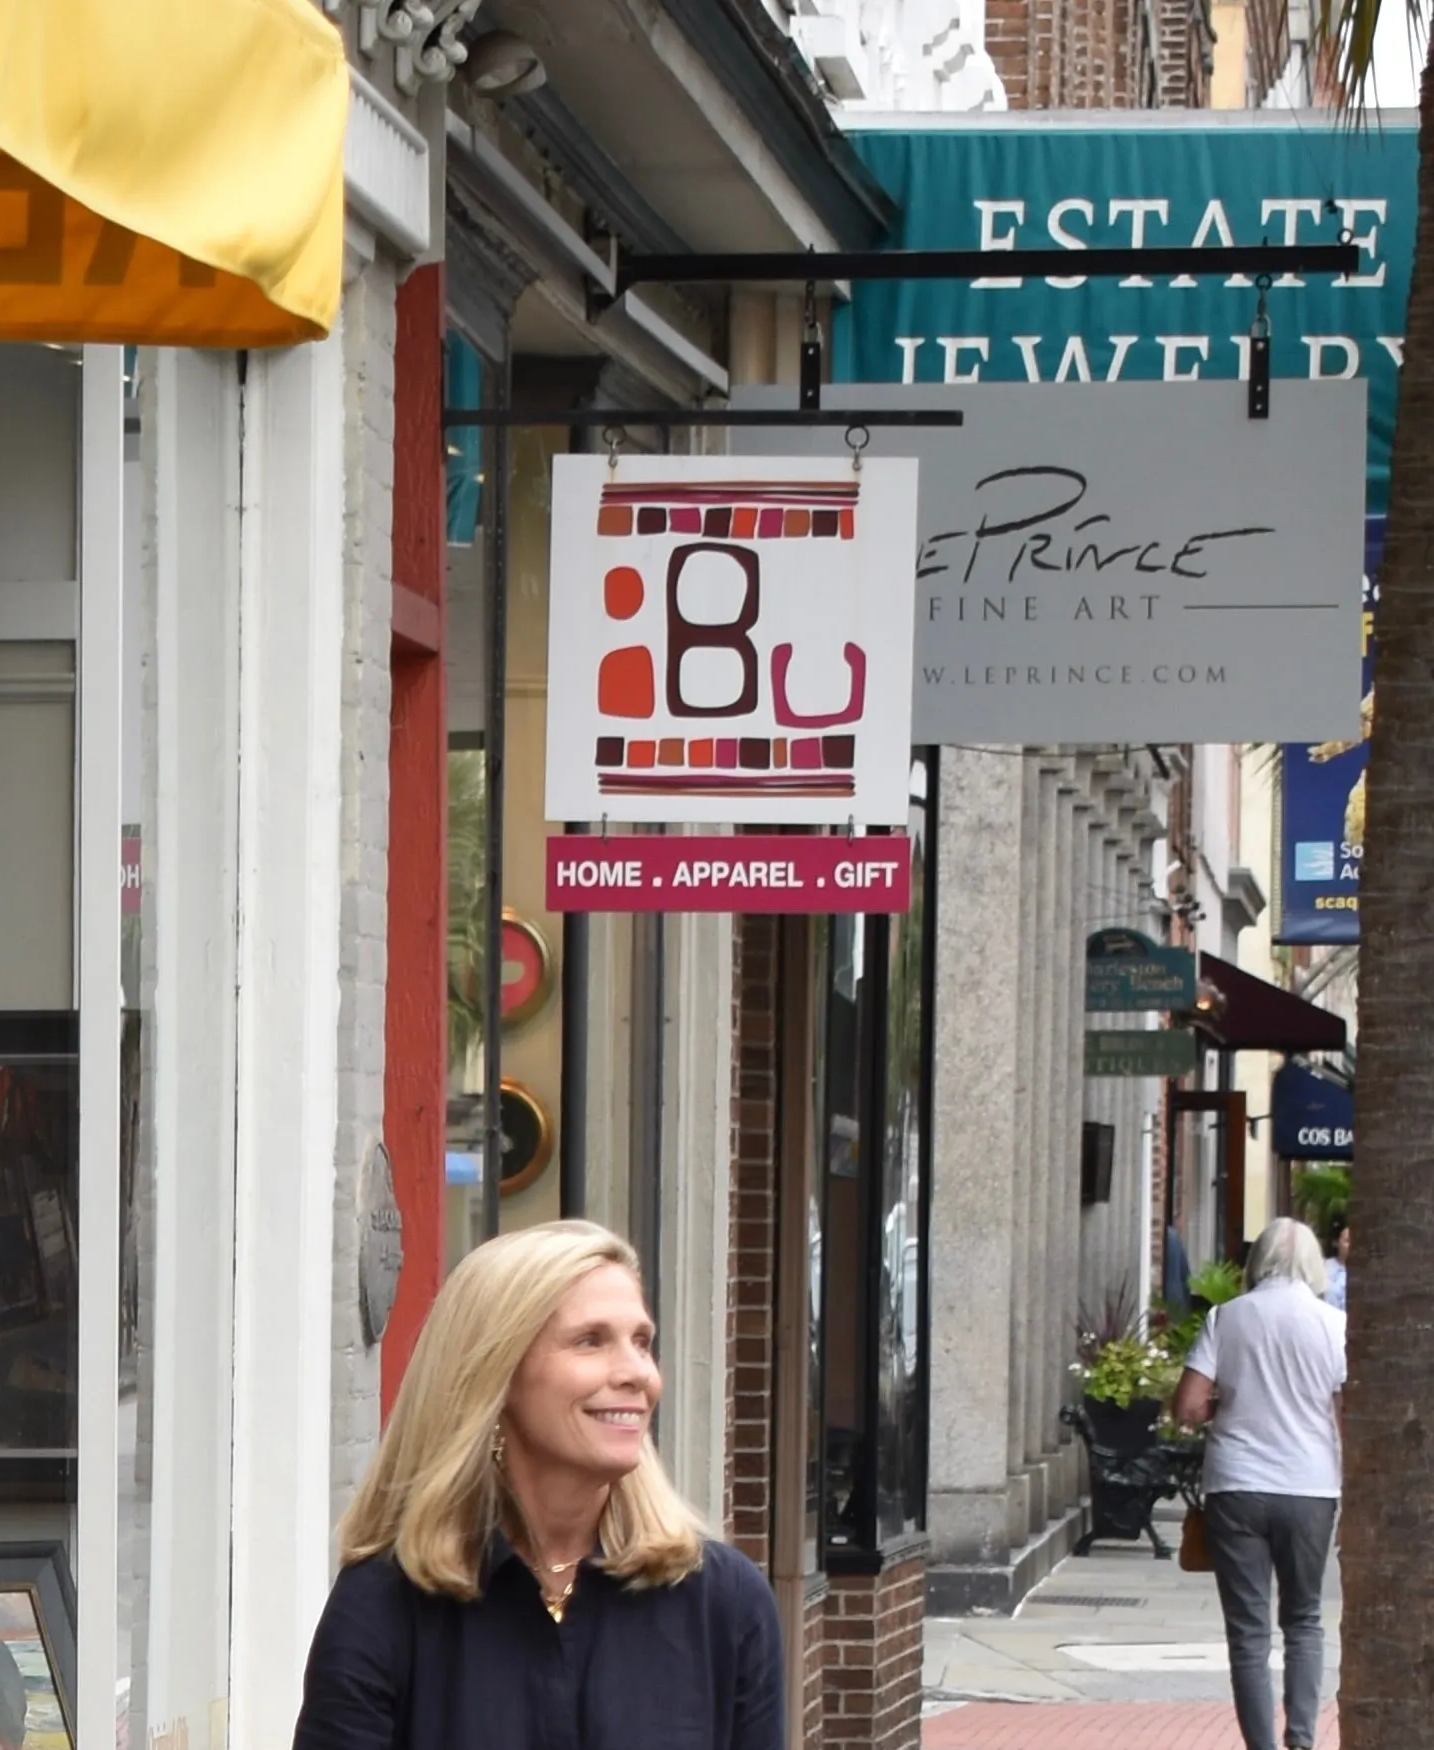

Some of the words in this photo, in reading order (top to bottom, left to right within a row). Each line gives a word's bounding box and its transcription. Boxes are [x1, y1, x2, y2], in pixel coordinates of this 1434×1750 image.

[970, 199, 1387, 288] ESTATE
[929, 597, 1038, 622] FINE
[1074, 595, 1161, 621] ART
[556, 862, 643, 888] HOME
[672, 861, 804, 888] APPAREL
[834, 861, 899, 888] GIFT
[1298, 1127, 1331, 1146] COS
